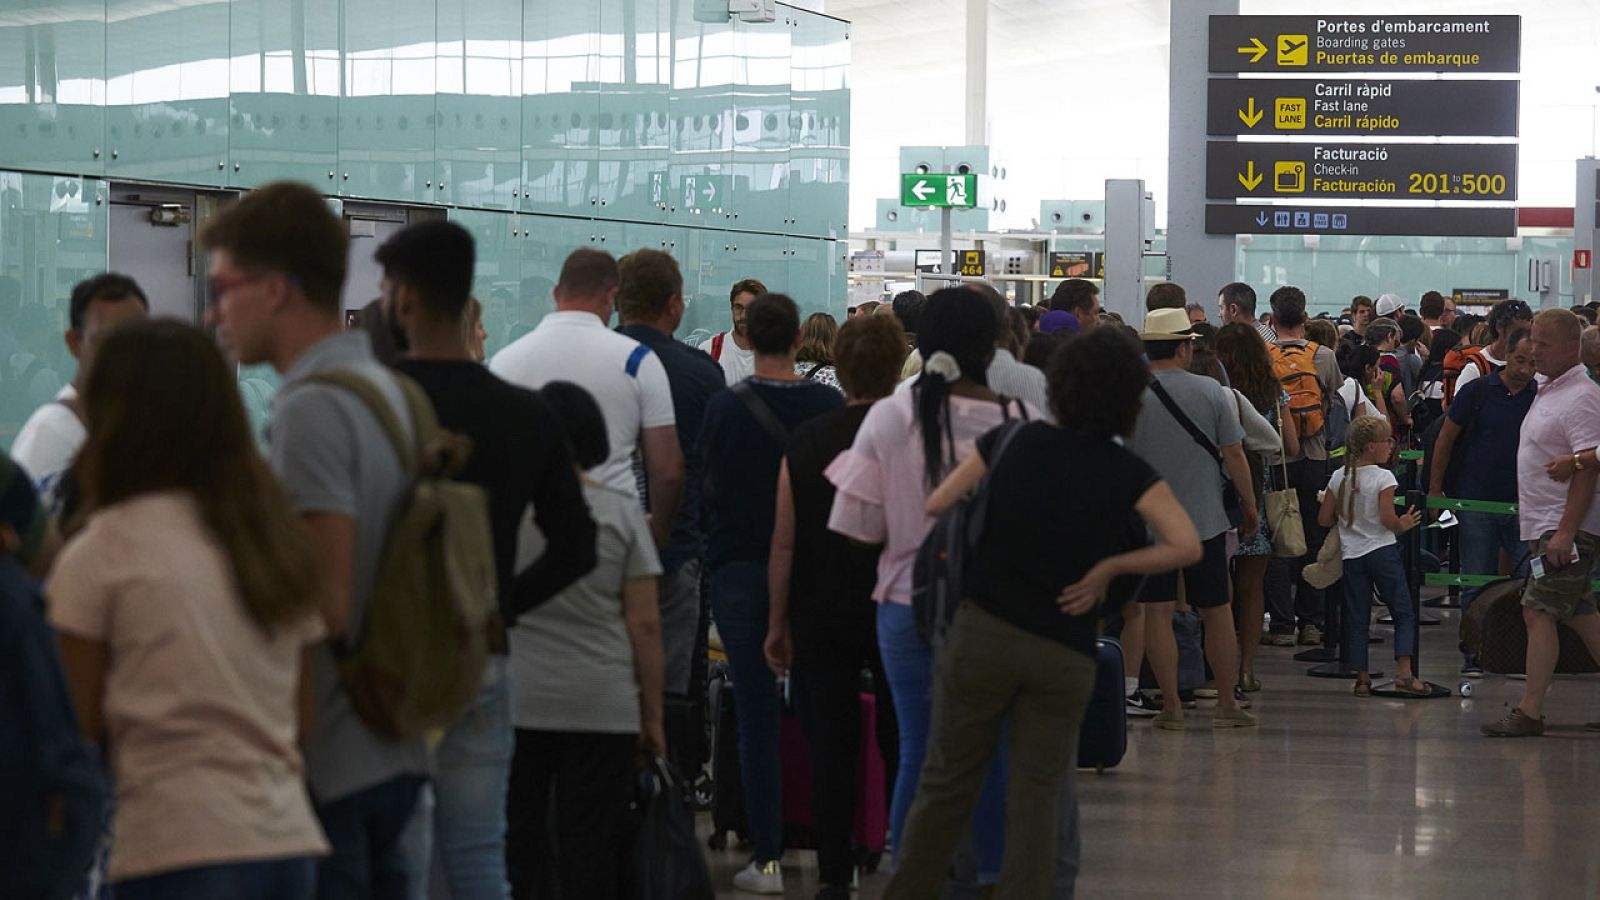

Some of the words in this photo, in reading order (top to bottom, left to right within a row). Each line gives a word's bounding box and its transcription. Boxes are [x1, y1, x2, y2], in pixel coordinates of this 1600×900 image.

[1317, 20, 1366, 33] Portes
[1371, 20, 1490, 33] d'embarcament
[1316, 37, 1369, 50] Boarding
[1373, 38, 1406, 50] gates
[1316, 52, 1375, 65] Puertas
[1380, 52, 1398, 65] de
[1404, 52, 1480, 66] embarque
[1315, 84, 1352, 96] Carril
[1356, 84, 1392, 98] ràpid
[1280, 104, 1301, 112] FAST
[1314, 100, 1339, 111] Fast
[1343, 100, 1368, 111] lane
[1279, 115, 1302, 123] LANE
[1314, 116, 1351, 128] Carril
[1355, 115, 1400, 130] rápido
[1314, 147, 1388, 161] Facturació
[1314, 164, 1359, 175] Check-in
[1313, 178, 1396, 192] Facturación
[1409, 173, 1450, 194] 201
[1462, 174, 1506, 195] 500
[961, 265, 982, 275] 464
